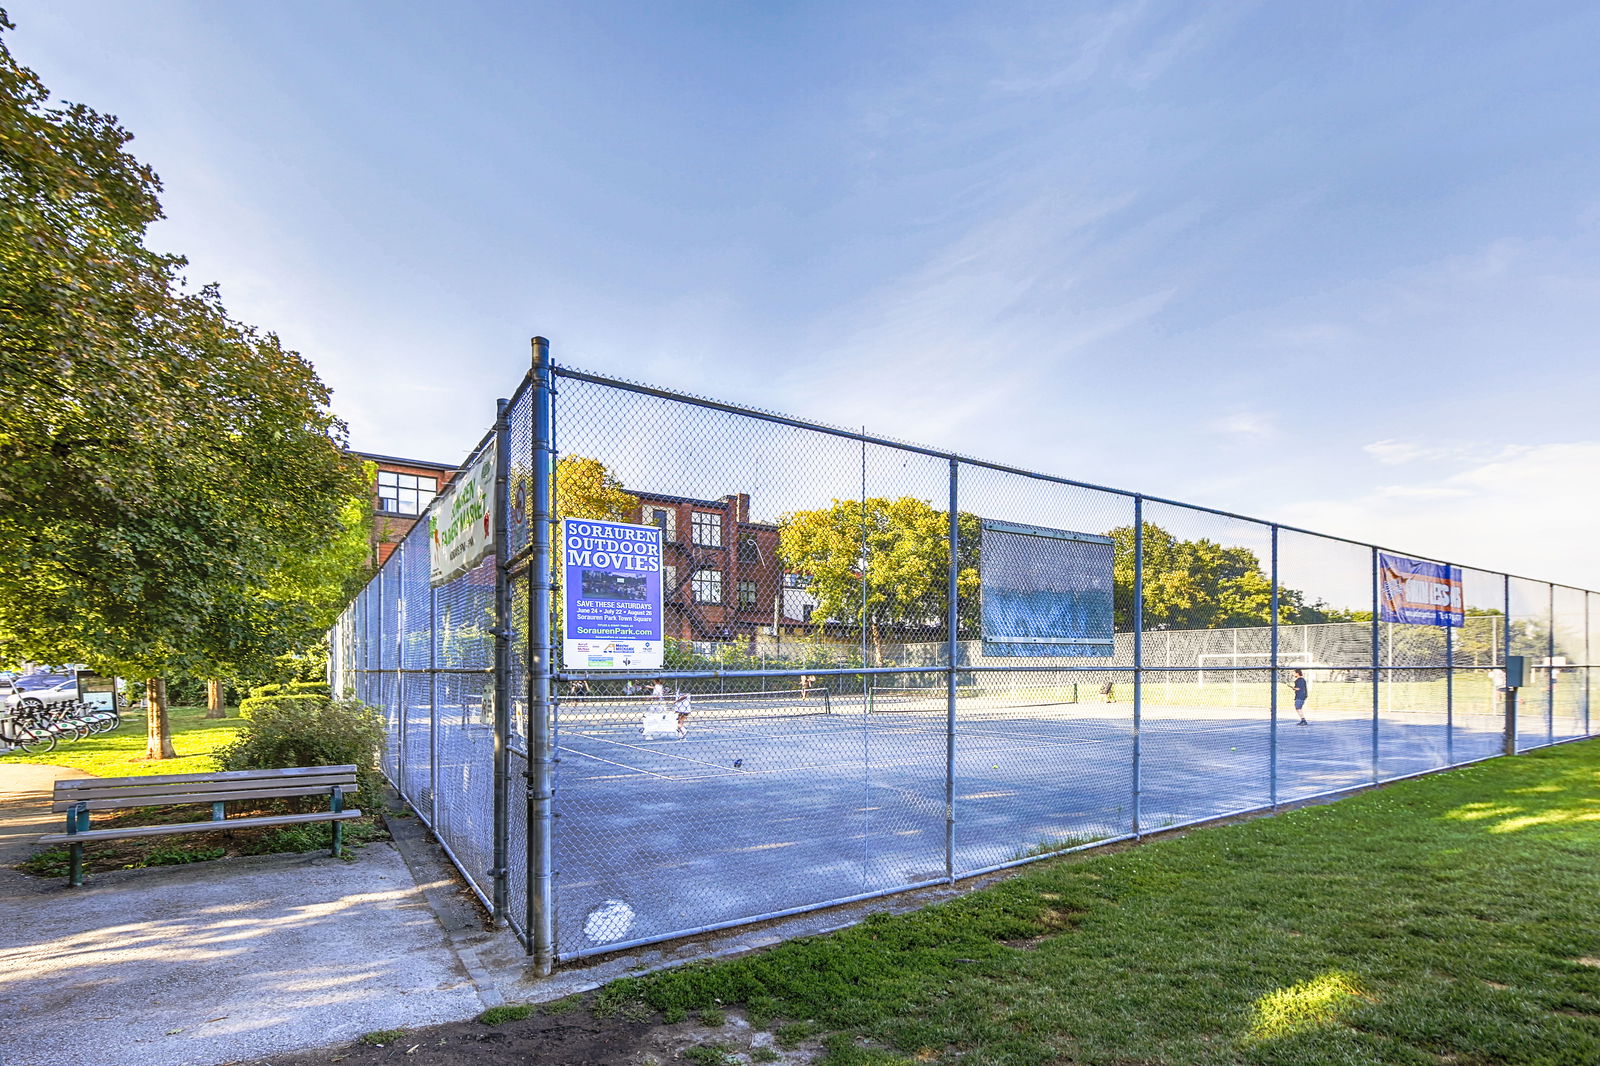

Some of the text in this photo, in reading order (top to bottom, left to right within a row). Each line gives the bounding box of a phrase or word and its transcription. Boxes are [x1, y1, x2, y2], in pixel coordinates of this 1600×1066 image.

[568, 523, 657, 543] SORAUREN
[568, 536, 659, 556] OUTDOOR
[567, 549, 659, 572] MOVIES
[616, 602, 652, 610] SATURDAYS
[577, 626, 652, 635] SoraurenPark.com
